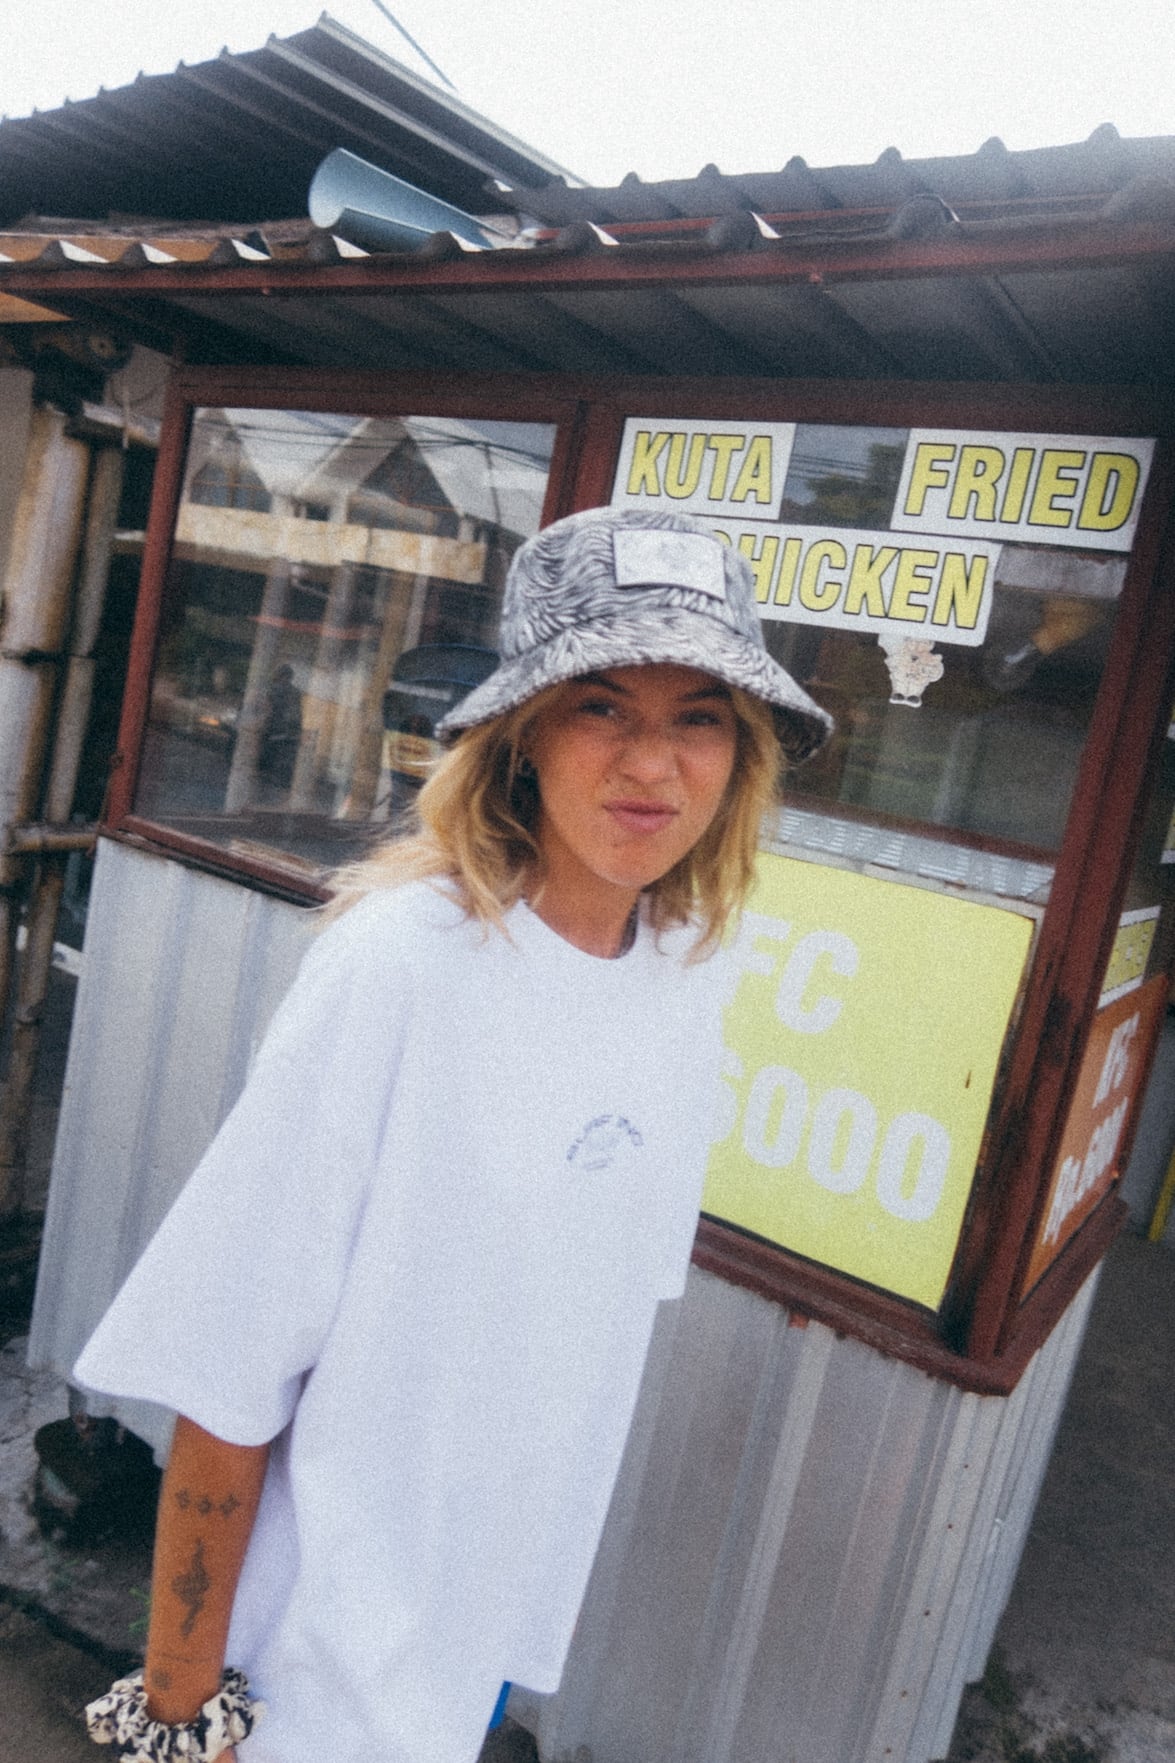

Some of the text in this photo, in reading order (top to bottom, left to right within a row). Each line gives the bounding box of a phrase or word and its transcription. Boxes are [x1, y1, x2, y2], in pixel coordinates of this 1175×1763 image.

[626, 431, 1141, 533] KUTA FRIED
[712, 529, 989, 630] HICKEN
